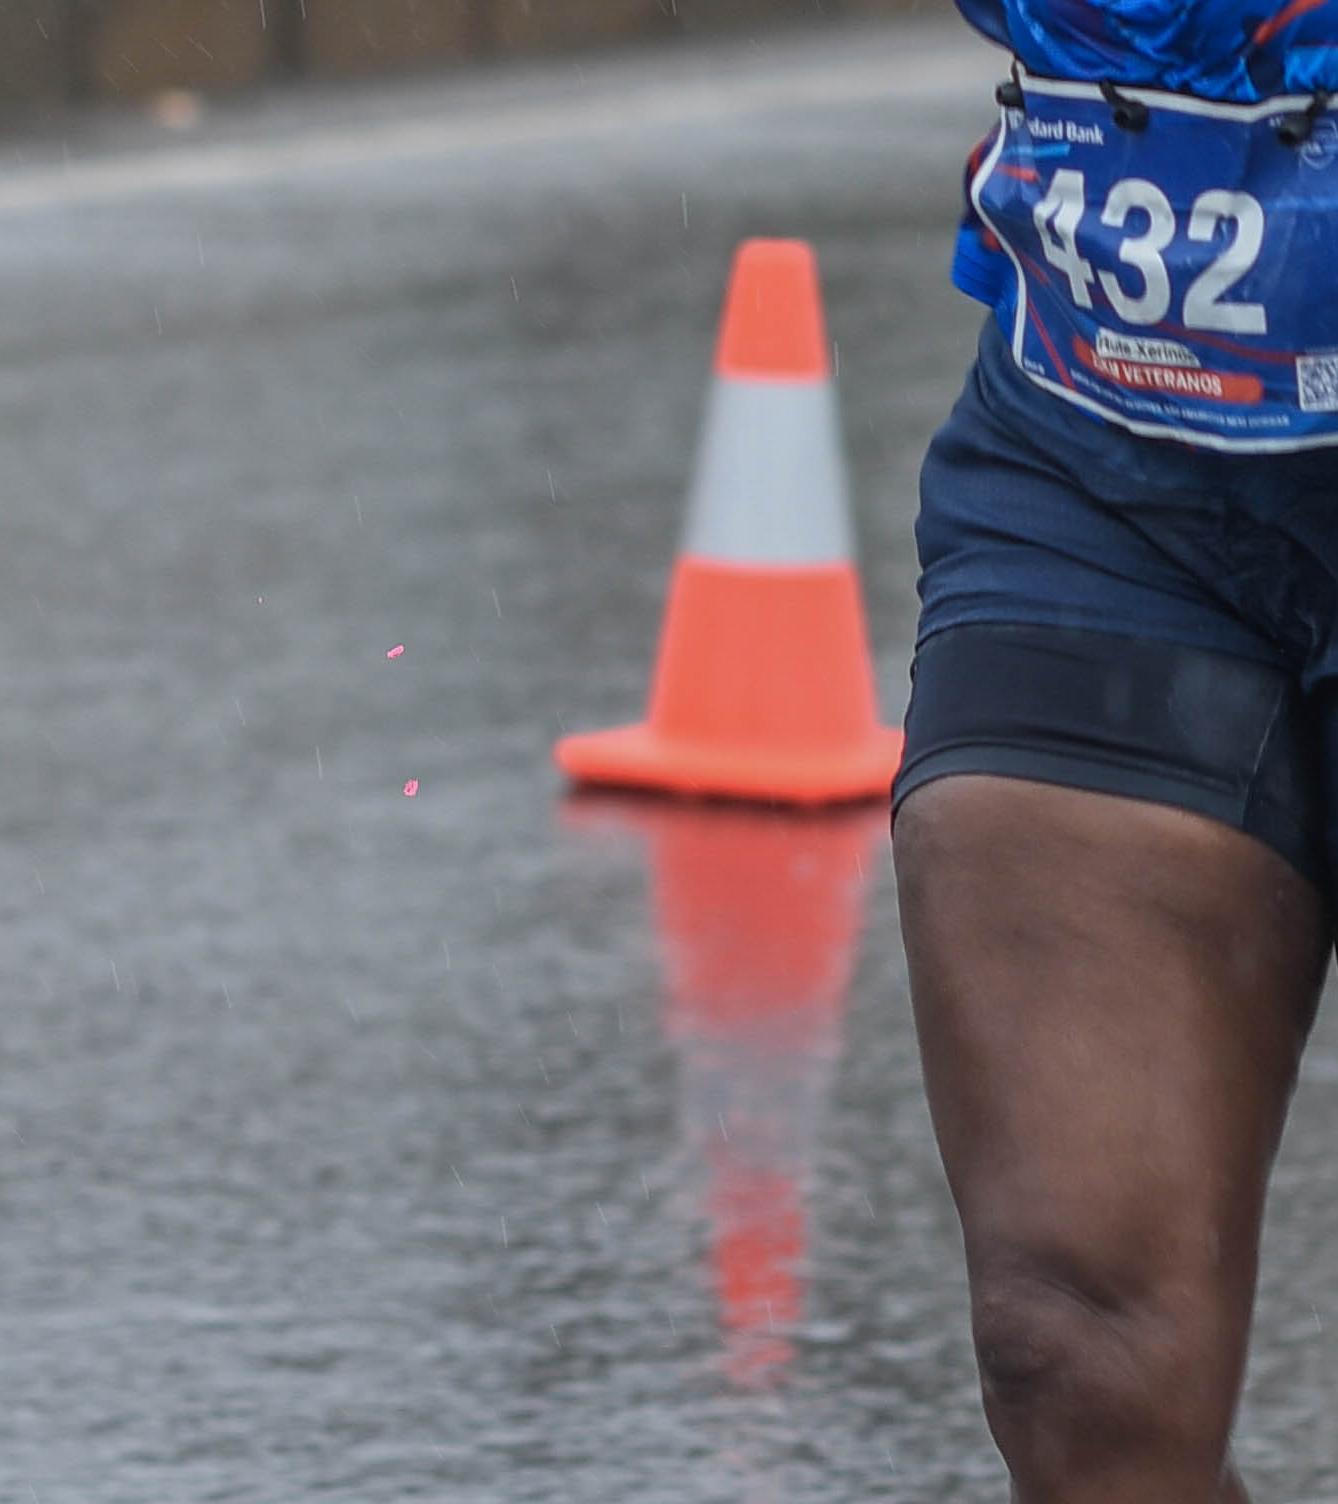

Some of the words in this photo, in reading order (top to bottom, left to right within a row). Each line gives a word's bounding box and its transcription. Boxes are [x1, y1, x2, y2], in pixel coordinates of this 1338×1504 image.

[1066, 119, 1105, 146] Bank
[1033, 168, 1267, 334] 432
[1121, 362, 1223, 397] VETERANOS
